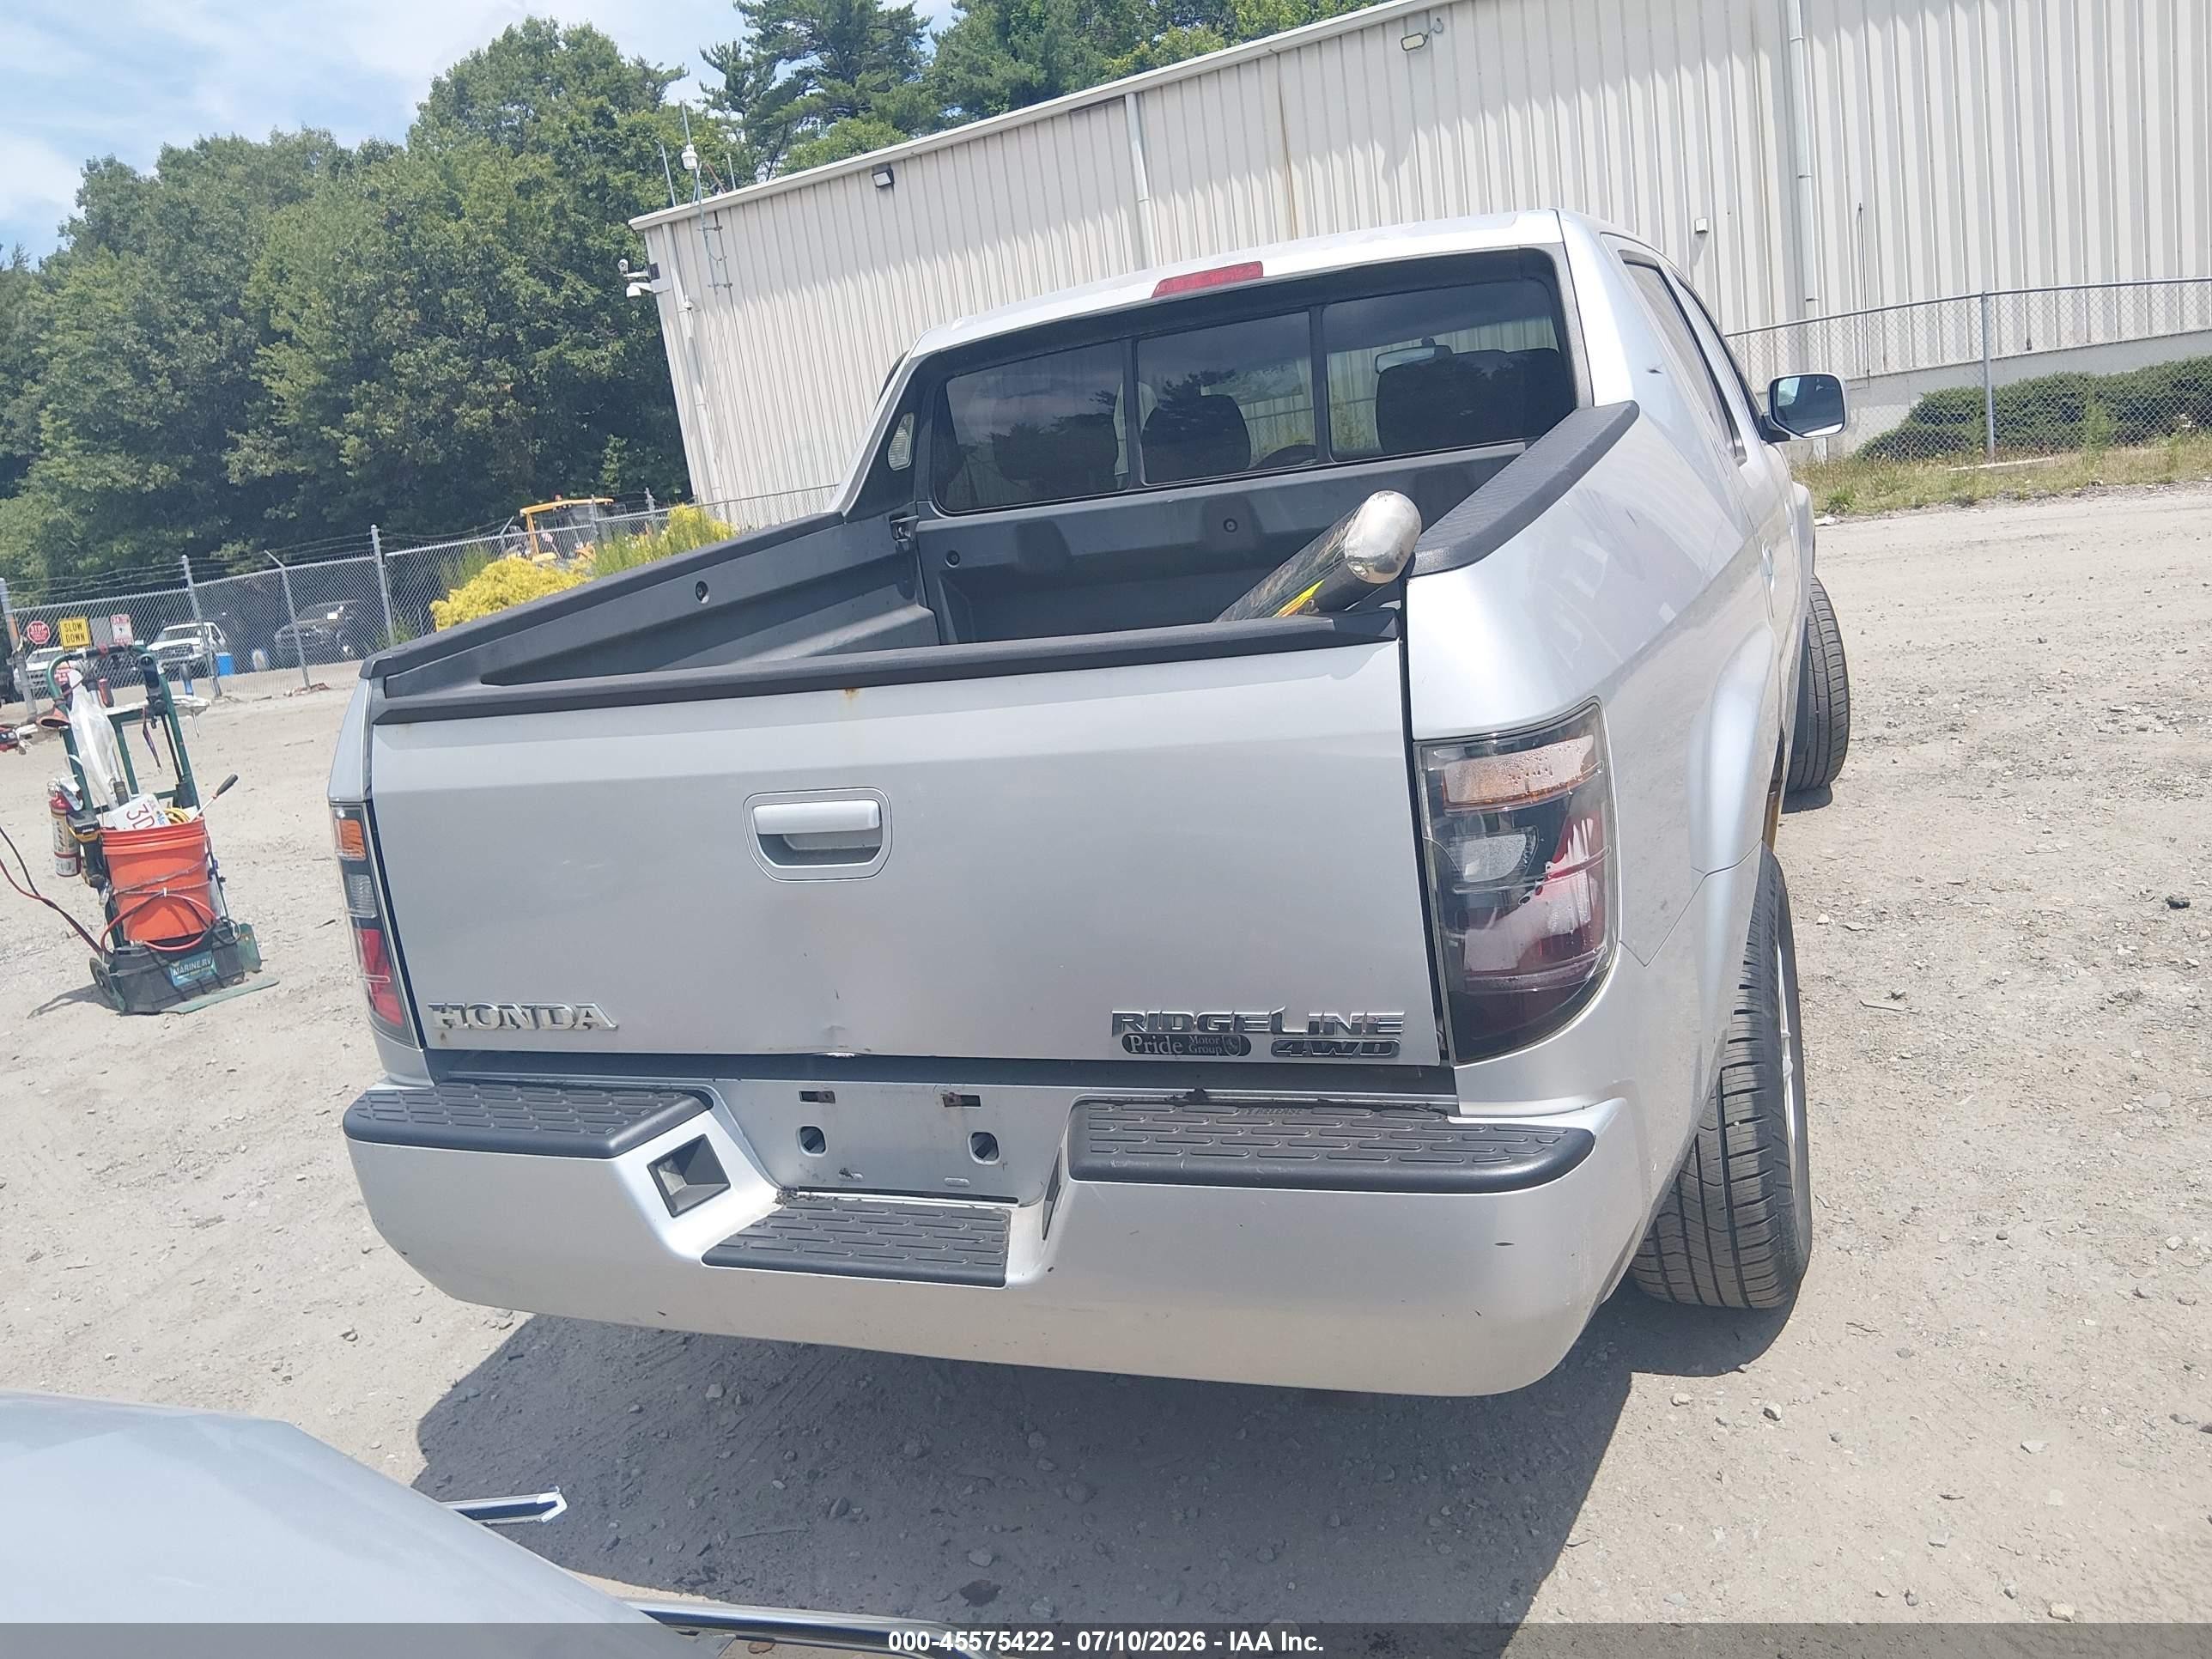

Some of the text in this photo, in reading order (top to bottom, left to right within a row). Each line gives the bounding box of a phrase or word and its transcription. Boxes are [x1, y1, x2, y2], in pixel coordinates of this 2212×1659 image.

[64, 622, 82, 632] SLOW
[65, 632, 85, 643] DOWN
[173, 960, 201, 976] MARINE
[201, 956, 213, 967] RV
[427, 1002, 619, 1030] HONDA
[1111, 1006, 1405, 1036] RIDGELINE
[1127, 1035, 1183, 1054] Pride
[1188, 1035, 1219, 1045] Motor
[1275, 1040, 1395, 1057] 4WD
[1188, 1044, 1223, 1057] Group
